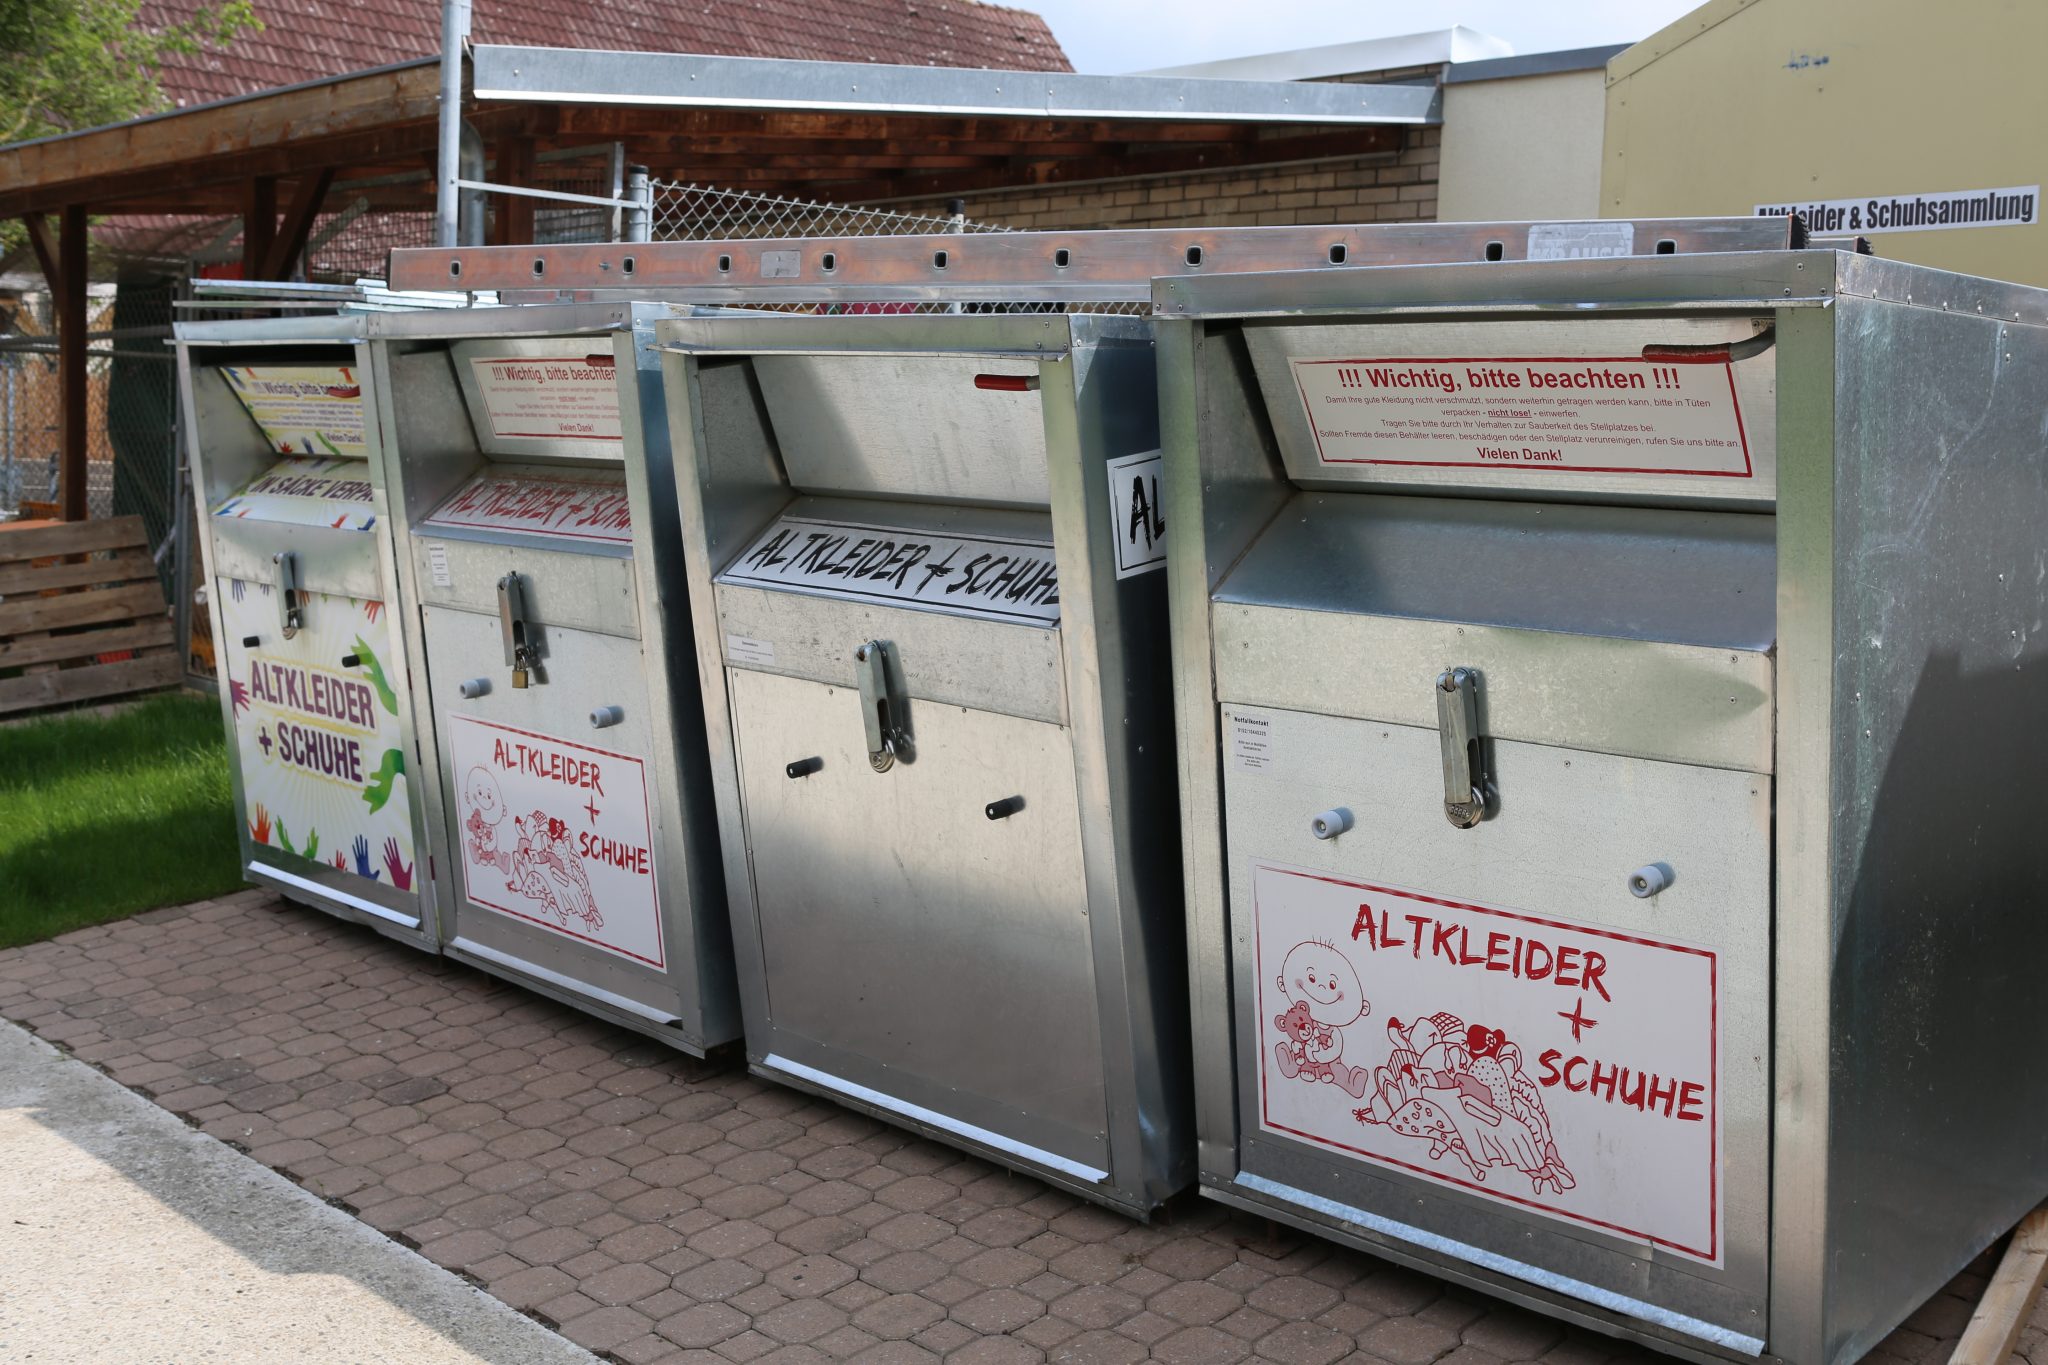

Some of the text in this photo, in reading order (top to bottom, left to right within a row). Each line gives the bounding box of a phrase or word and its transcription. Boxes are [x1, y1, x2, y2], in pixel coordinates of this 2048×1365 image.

[1850, 206, 1862, 230] &
[1866, 192, 2035, 229] Schuhsammlung
[298, 382, 321, 394] bitte
[492, 366, 504, 380] !!!
[504, 366, 546, 384] Wichtig,
[546, 366, 569, 380] bitte
[1338, 368, 1681, 392] !!! Wichtig, bitte beachten !!!
[1326, 396, 1347, 404] Damit
[1364, 396, 1380, 405] gute
[1381, 396, 1414, 406] Kleidung
[1434, 397, 1484, 406] verschmutzt,
[1558, 398, 1594, 408] getragen
[1628, 399, 1652, 407] kann,
[1675, 399, 1684, 407] in
[1686, 399, 1711, 408] Tüten
[1488, 409, 1509, 418] nicht
[1510, 409, 1532, 418] lose!
[1539, 410, 1580, 418] einwerfen.
[558, 422, 594, 432] Vielen Dank!
[1381, 419, 1407, 428] Tragen
[1408, 420, 1421, 428] Sie
[1422, 420, 1438, 428] bitte
[1474, 420, 1512, 429] Verhalten
[1528, 422, 1572, 430] Sauberkeit
[1573, 422, 1588, 430] des
[1590, 422, 1638, 433] Stellplatzes
[1640, 424, 1656, 432] bei.
[1459, 433, 1507, 442] beschädigen
[1528, 434, 1544, 442] den
[1546, 434, 1583, 444] Stellplatz
[1584, 436, 1644, 446] verunreinigen,
[1646, 437, 1668, 446] rufen
[1670, 437, 1685, 446] Sie
[1705, 439, 1724, 447] bitte
[1477, 447, 1563, 462] Vielen Dank!
[250, 476, 280, 493] IN
[270, 474, 330, 497] SÄCKE
[446, 482, 577, 526] ALTKLEIDER
[555, 492, 597, 528] +
[746, 528, 932, 590] ALTKLEIDER
[912, 544, 964, 598] +
[251, 660, 376, 730] ALTKLEIDER
[258, 722, 364, 784] + SCHUHE
[494, 738, 604, 797] ALTKLEIDER
[584, 795, 601, 826] +
[579, 831, 650, 875] SCHUHE
[1351, 903, 1612, 1002] ALTKLEIDER
[1558, 997, 1598, 1044] +
[1538, 1048, 1706, 1122] SCHUHE
